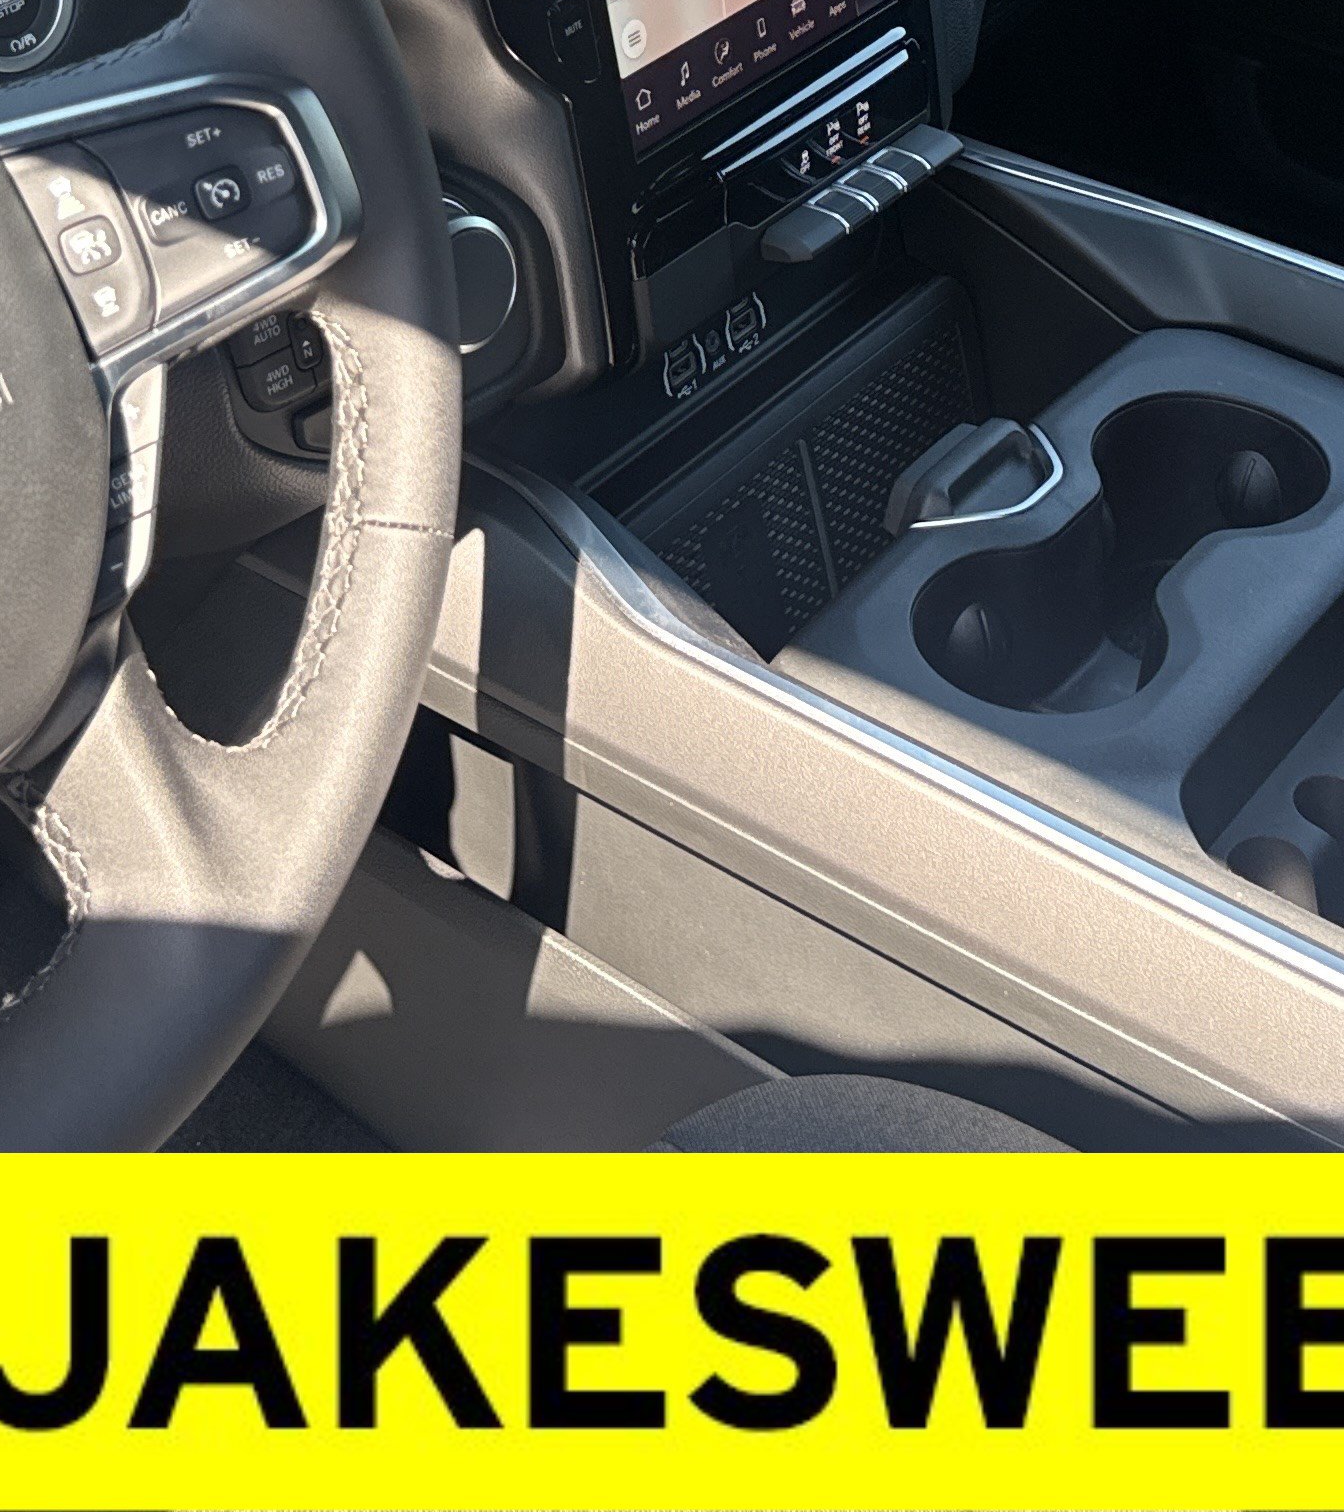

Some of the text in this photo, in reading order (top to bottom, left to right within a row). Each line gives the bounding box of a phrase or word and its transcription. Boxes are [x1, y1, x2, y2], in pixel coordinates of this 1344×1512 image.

[828, 0, 847, 17] Apps
[564, 19, 583, 37] MUTE
[788, 18, 816, 41] Vehicle
[753, 42, 778, 63] Phone
[712, 62, 745, 88] Comfort
[676, 89, 702, 110] Media
[635, 114, 661, 135] Home
[825, 139, 844, 157] FRONT
[257, 163, 286, 184] RES
[150, 200, 188, 226] CANC
[254, 325, 281, 346] AUTO
[752, 332, 760, 345] 2
[303, 348, 313, 358] N
[266, 364, 290, 383] 4WD
[267, 374, 295, 396] HIGH
